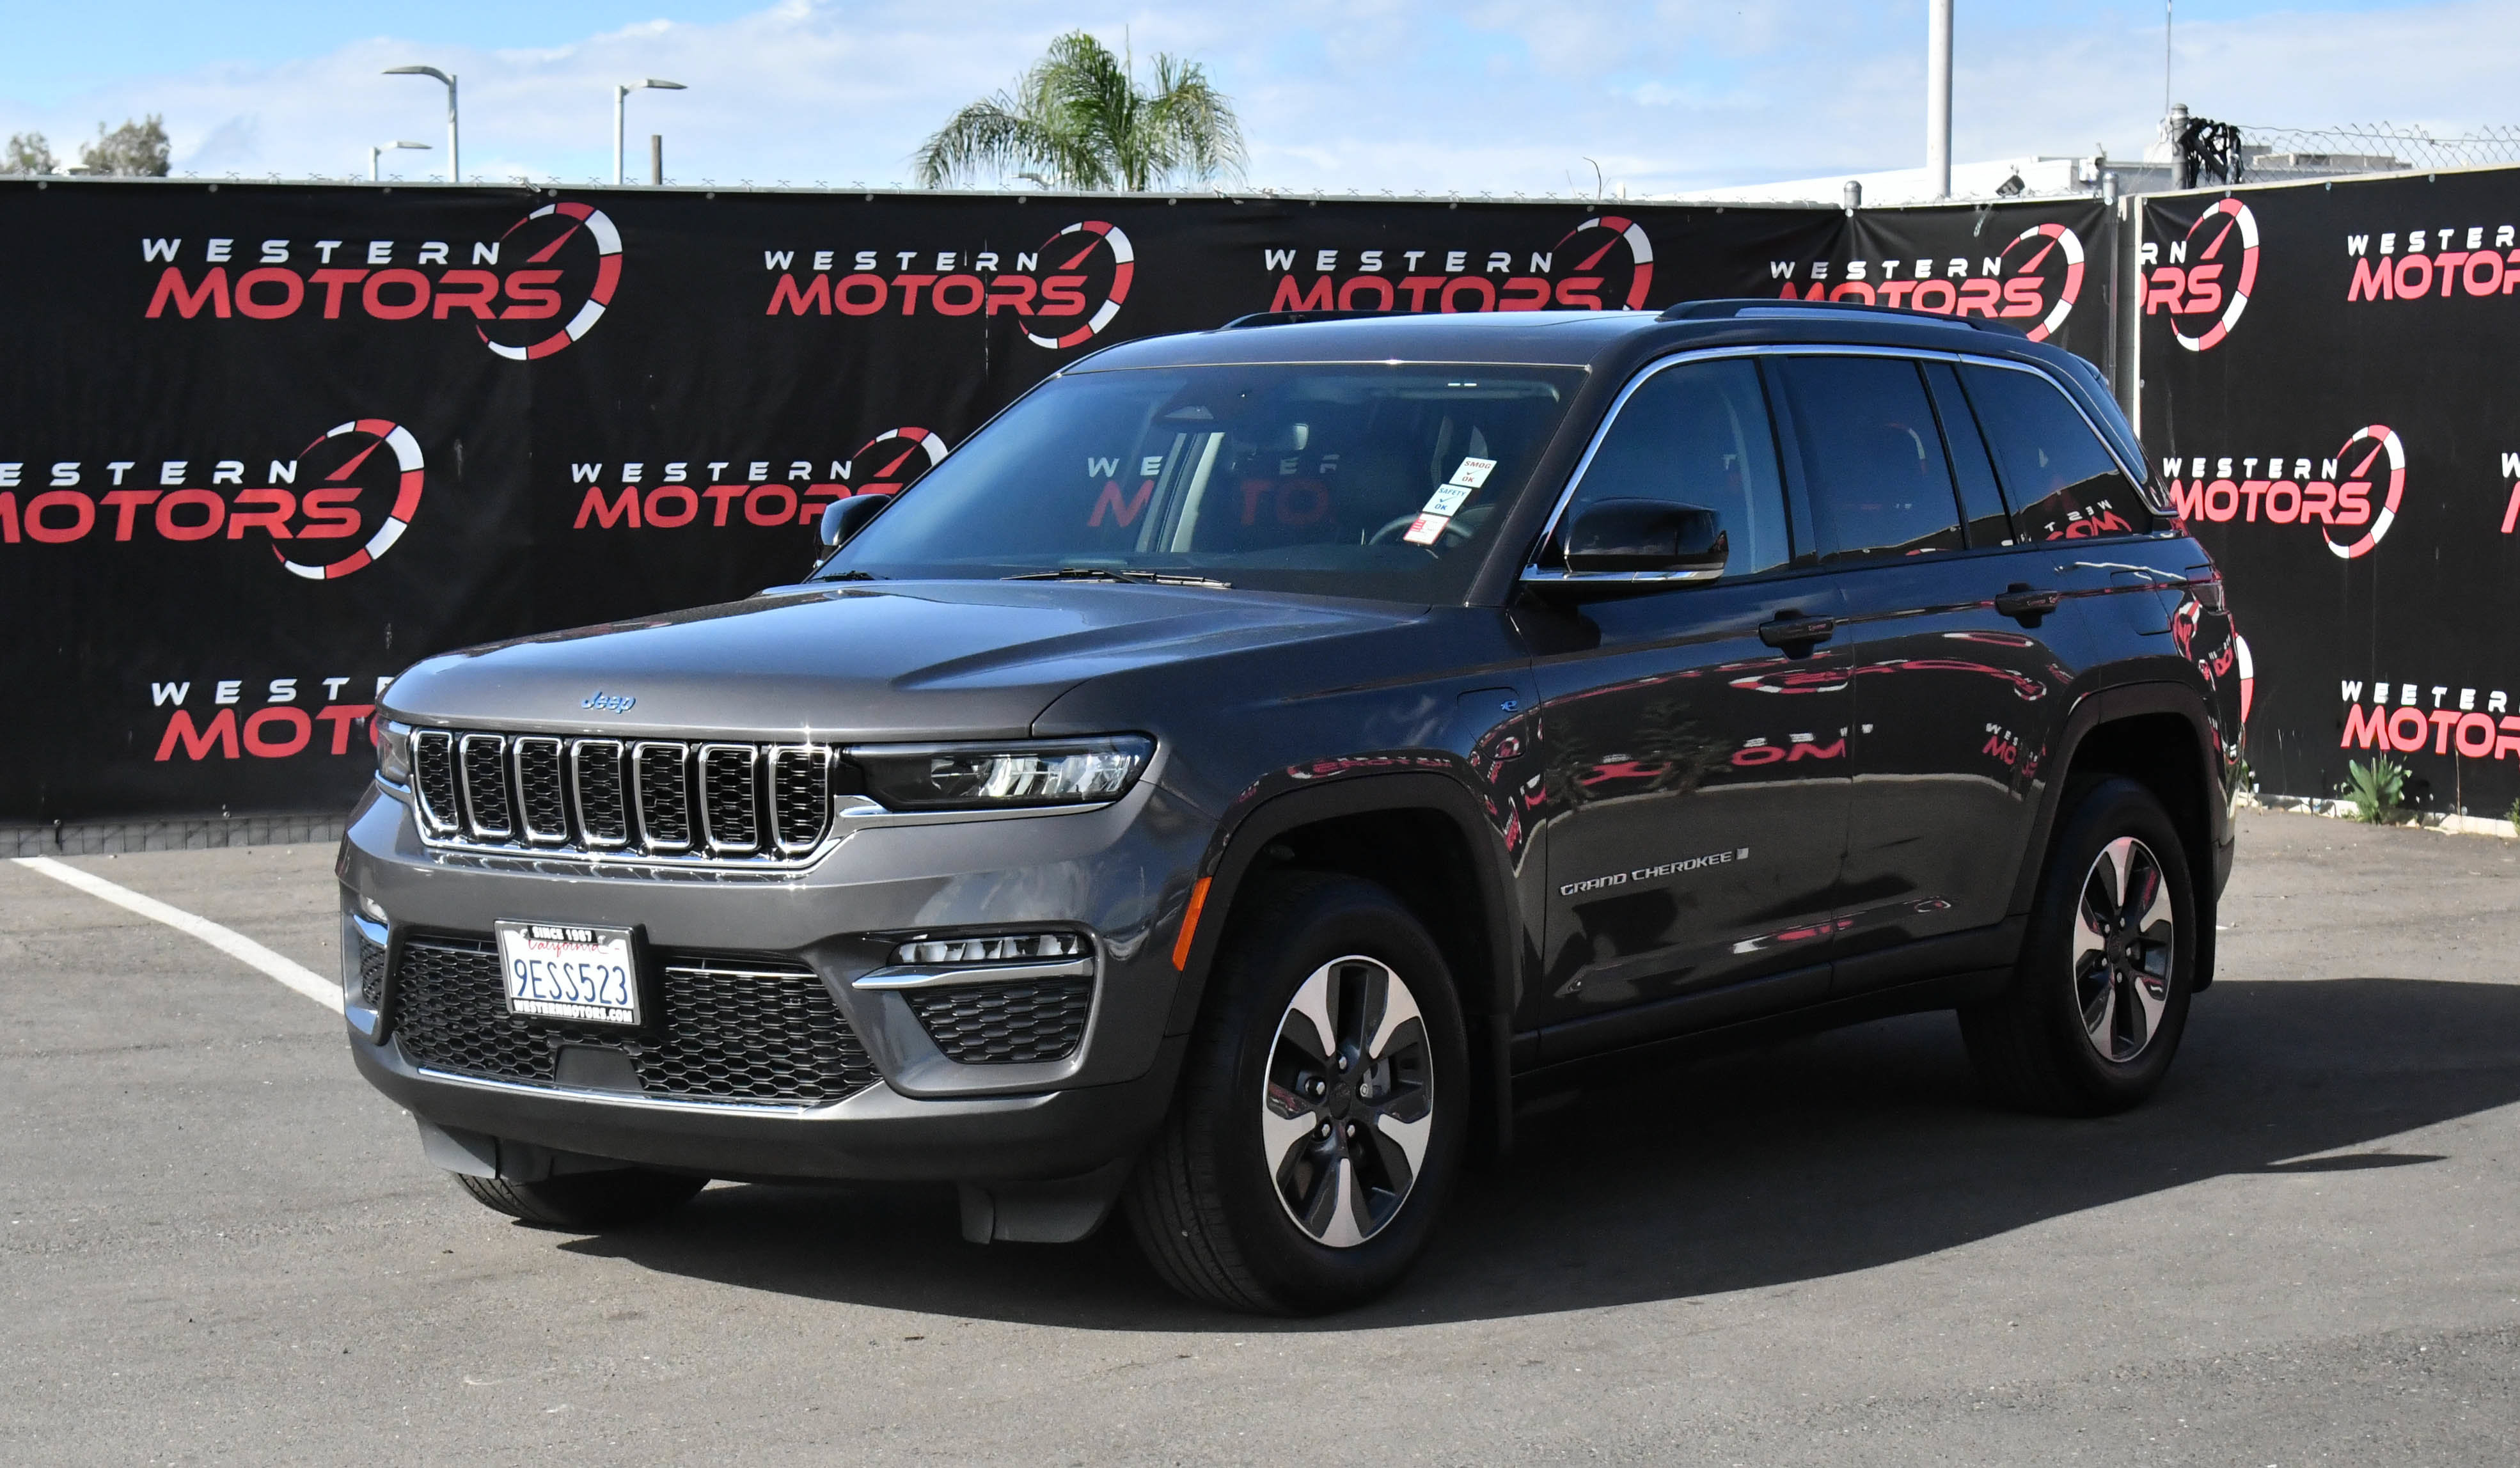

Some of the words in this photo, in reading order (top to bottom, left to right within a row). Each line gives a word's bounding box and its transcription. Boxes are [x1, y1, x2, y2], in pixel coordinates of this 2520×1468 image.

[143, 239, 500, 265] WESTERN
[764, 251, 1037, 271] WESTERN
[1264, 249, 1552, 273] WESTERN
[1770, 257, 2001, 280] WESTERN
[146, 267, 563, 320] MOTORS
[766, 274, 1088, 316] MOTORS
[572, 461, 852, 483] WESTERN
[1464, 461, 1492, 469] SMOG
[2162, 457, 2338, 480] WESTERN
[1438, 487, 1467, 497] SAFETY
[2170, 479, 2373, 528] MOTORS
[0, 488, 363, 544] OTORS
[581, 691, 636, 714] Jeep
[155, 704, 380, 761] MOT
[1559, 873, 1627, 896] GRAND
[1631, 851, 1733, 881] CHEROKEE
[532, 926, 564, 940] SINCE
[514, 959, 627, 1005] 9ESS523
[514, 1000, 633, 1023] WESTERNMOTORS.COM
